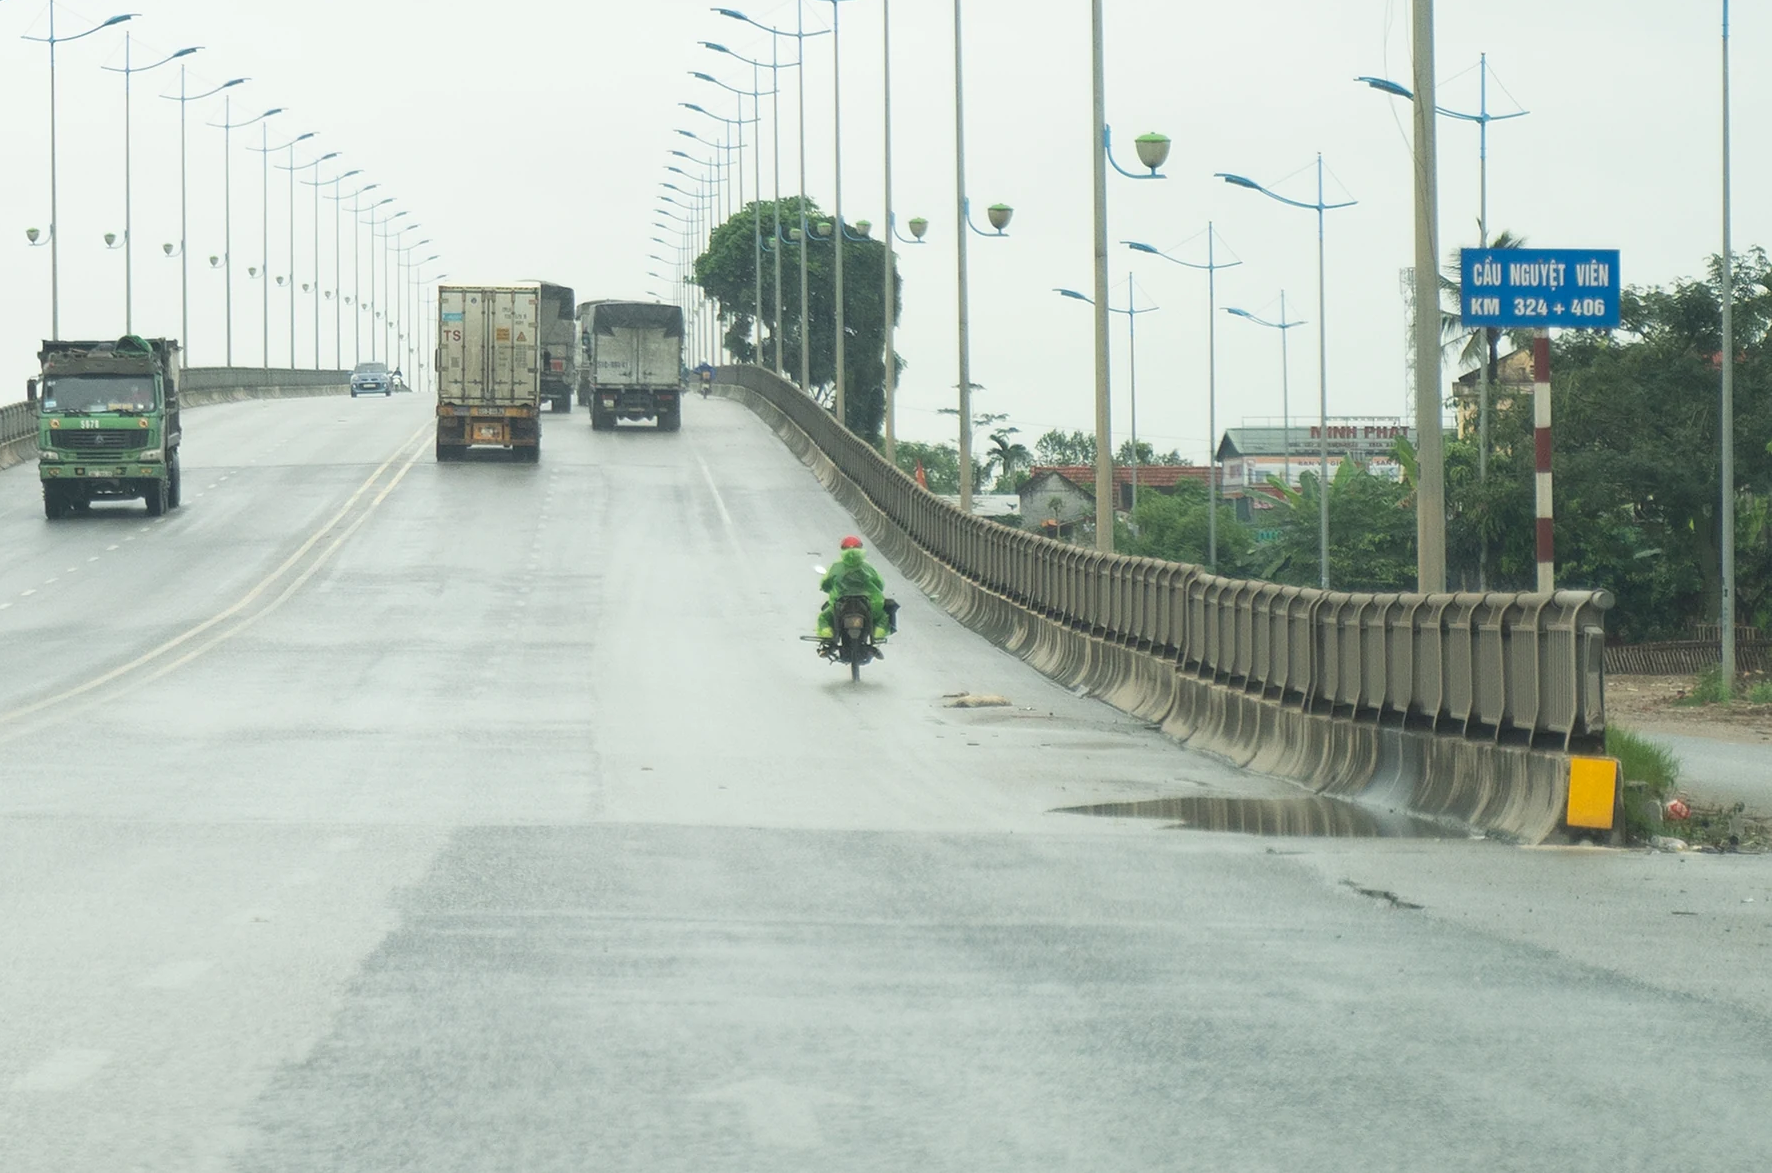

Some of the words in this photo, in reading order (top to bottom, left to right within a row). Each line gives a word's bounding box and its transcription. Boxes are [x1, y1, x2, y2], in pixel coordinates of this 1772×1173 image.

[1473, 255, 1502, 286] CẦU
[1509, 259, 1566, 291] NGUYỆT
[1575, 259, 1609, 287] VIÊN
[1471, 298, 1500, 315] KM
[1514, 298, 1548, 316] 324
[1571, 298, 1605, 316] 406
[443, 330, 461, 342] TS
